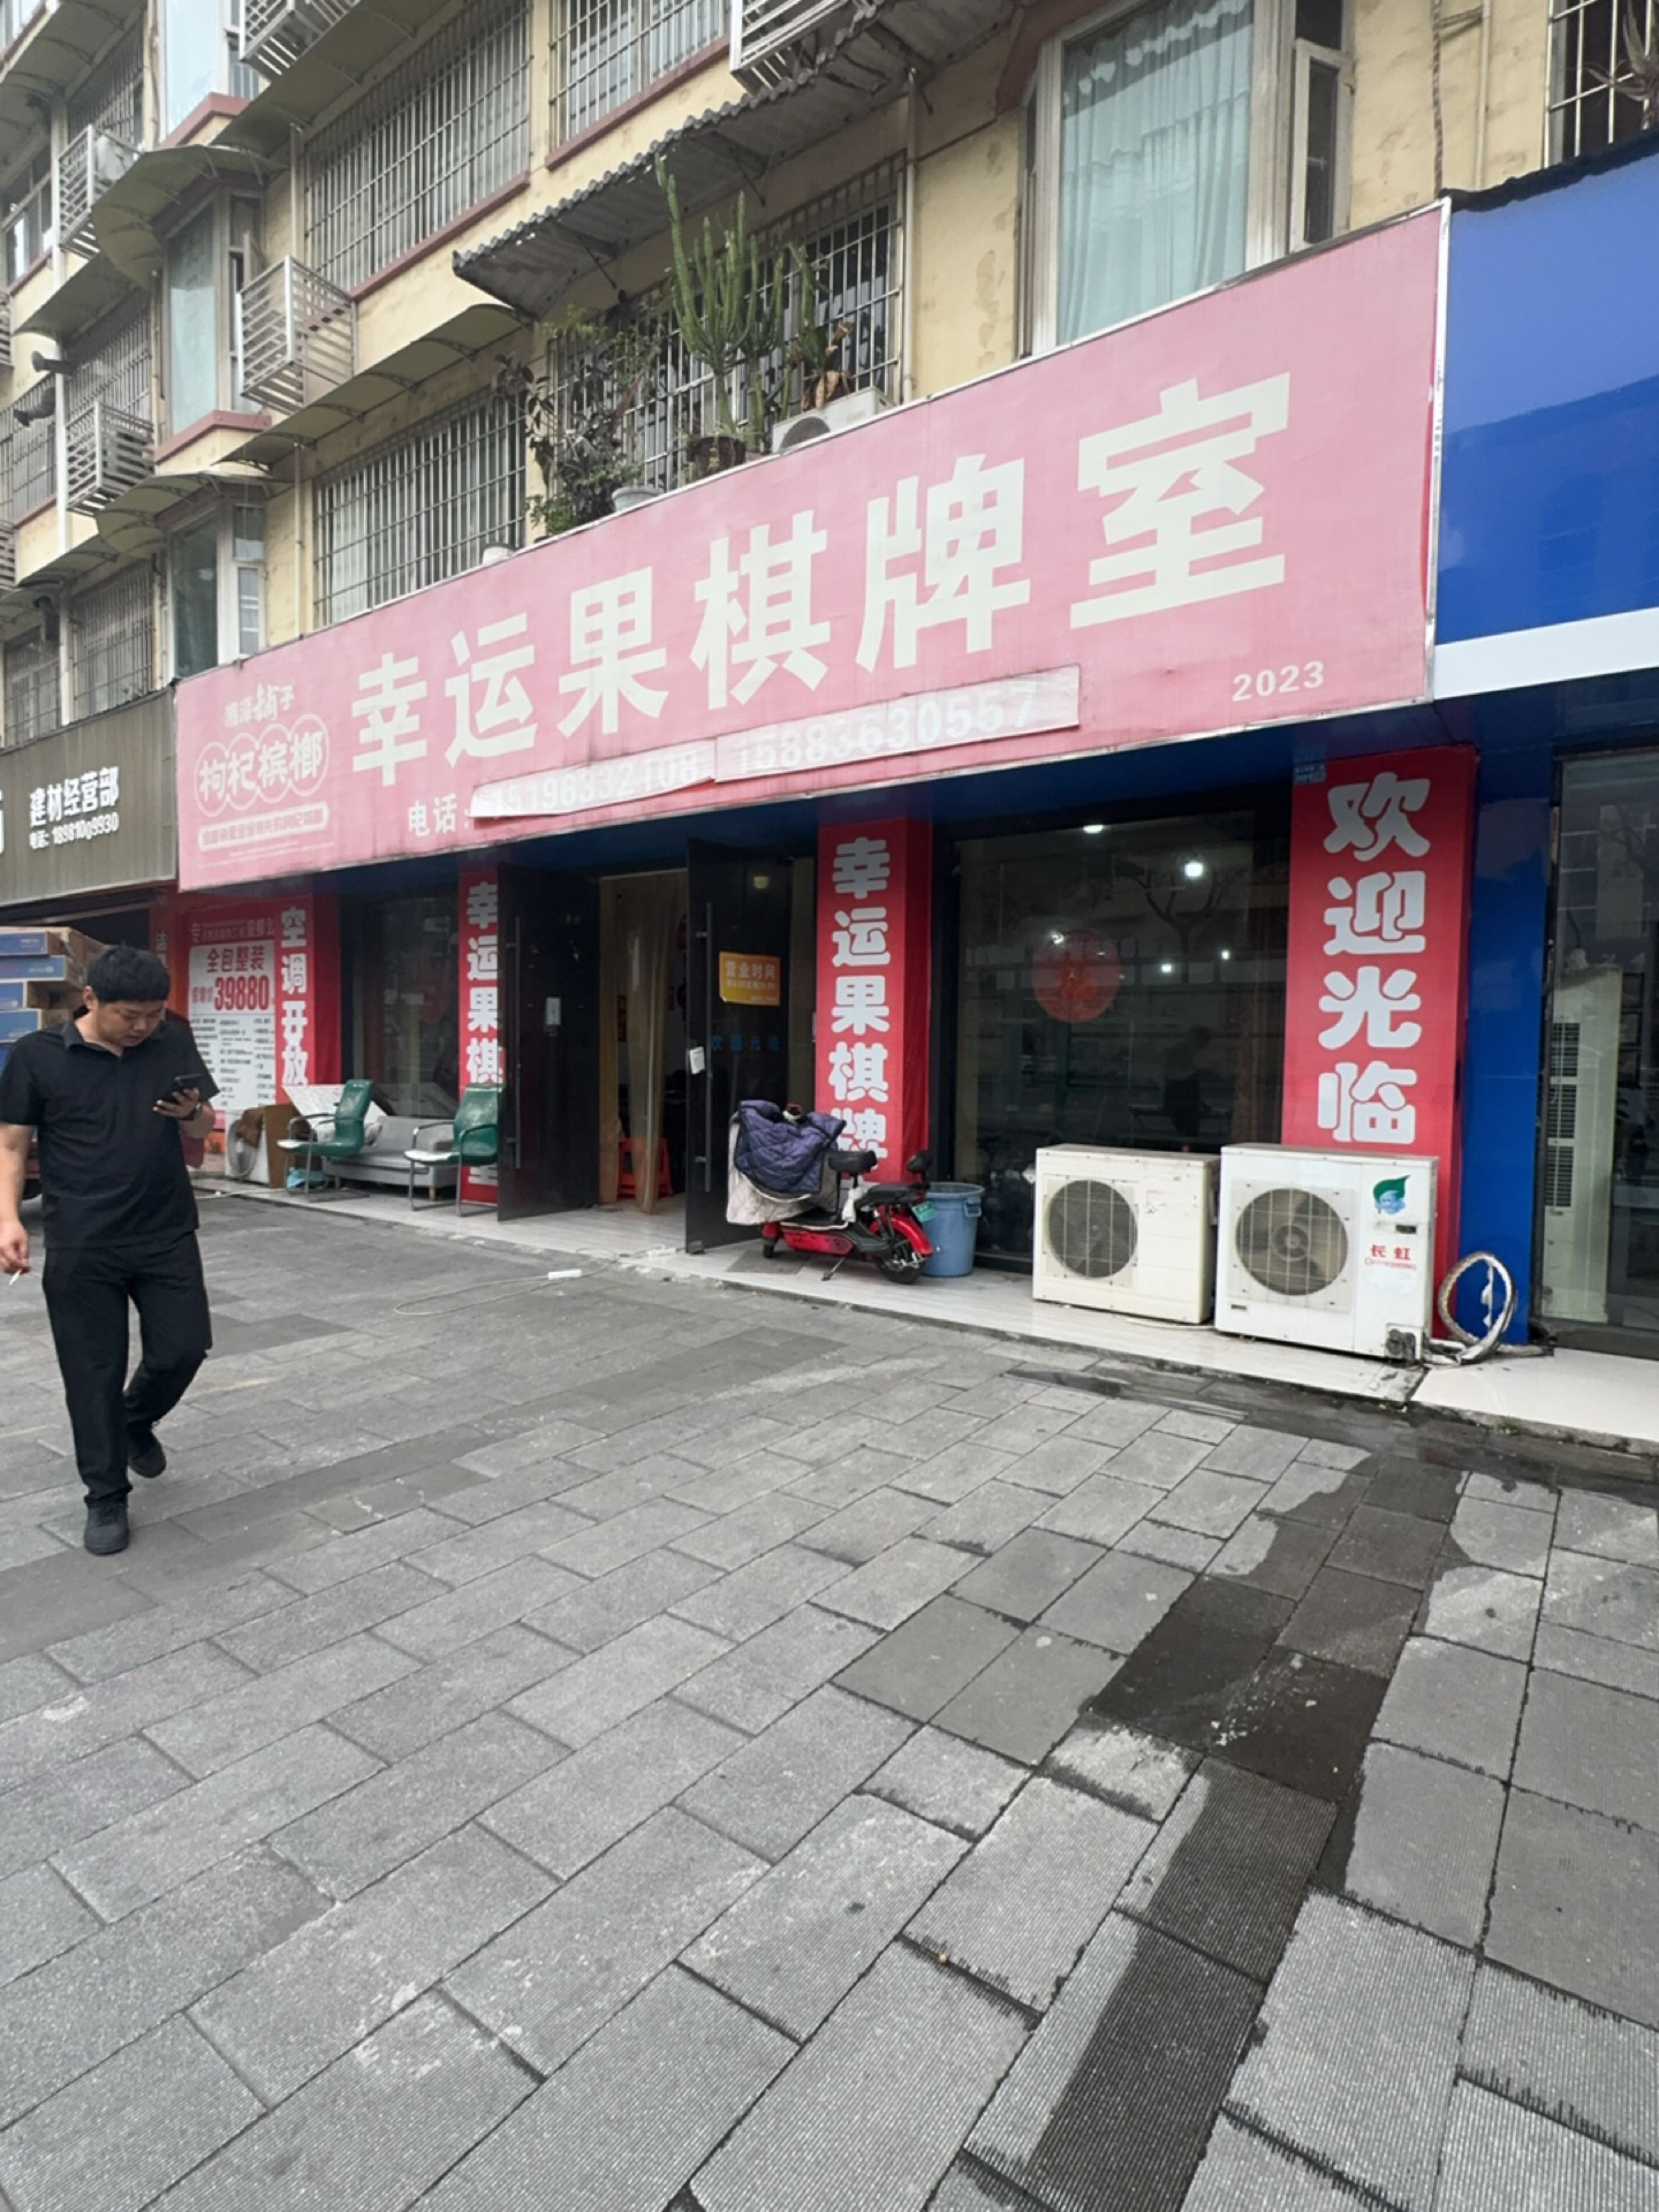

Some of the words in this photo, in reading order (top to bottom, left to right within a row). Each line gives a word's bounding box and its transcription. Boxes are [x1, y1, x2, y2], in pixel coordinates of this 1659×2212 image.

[350, 373, 1291, 787] 幸运果棋牌室
[1231, 660, 1324, 702] 2023
[29, 765, 120, 828] 建材经营部
[198, 731, 323, 801] 枸杞槟榔
[207, 945, 266, 974] 全包整装
[215, 975, 269, 1011] 39880
[1317, 771, 1431, 1145] 欢迎光临
[281, 906, 308, 1087] 空调开放
[828, 837, 890, 1170] 幸运果棋牌
[466, 880, 504, 1186] 幸运果棋
[1370, 1244, 1411, 1260] 长虹
